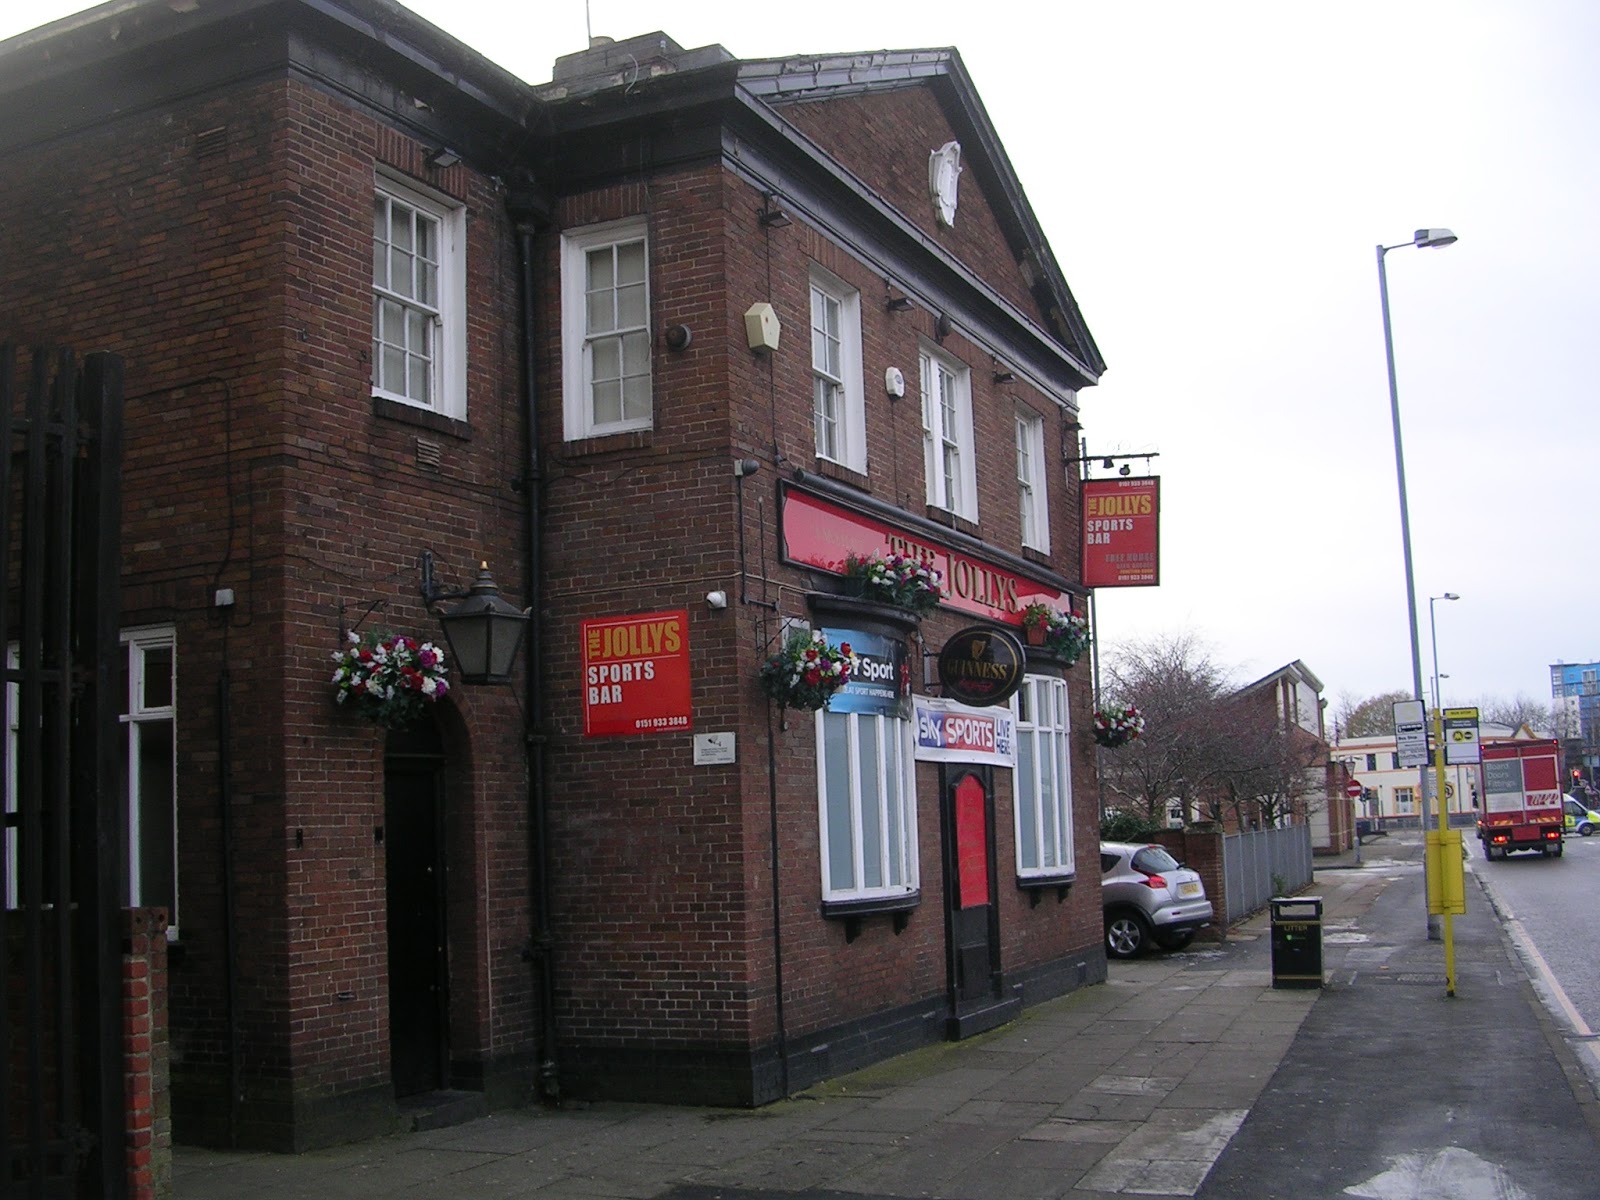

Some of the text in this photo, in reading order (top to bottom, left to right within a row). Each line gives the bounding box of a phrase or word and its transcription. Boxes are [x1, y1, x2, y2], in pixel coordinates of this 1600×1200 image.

[1088, 495, 1151, 516] THE JOLLYS
[1087, 518, 1133, 532] SPORTS
[1087, 532, 1111, 544] BAR
[940, 552, 1019, 614] JOLLYS
[588, 621, 681, 659] THE JOLLYS
[588, 661, 655, 685] SPORTS
[862, 657, 894, 681] Sport
[947, 658, 1008, 679] GUINNESS
[588, 685, 623, 705] BAR
[635, 719, 652, 728] 0151
[653, 717, 667, 727] 933
[945, 717, 993, 747] SPORTS
[996, 719, 1010, 738] LIVE
